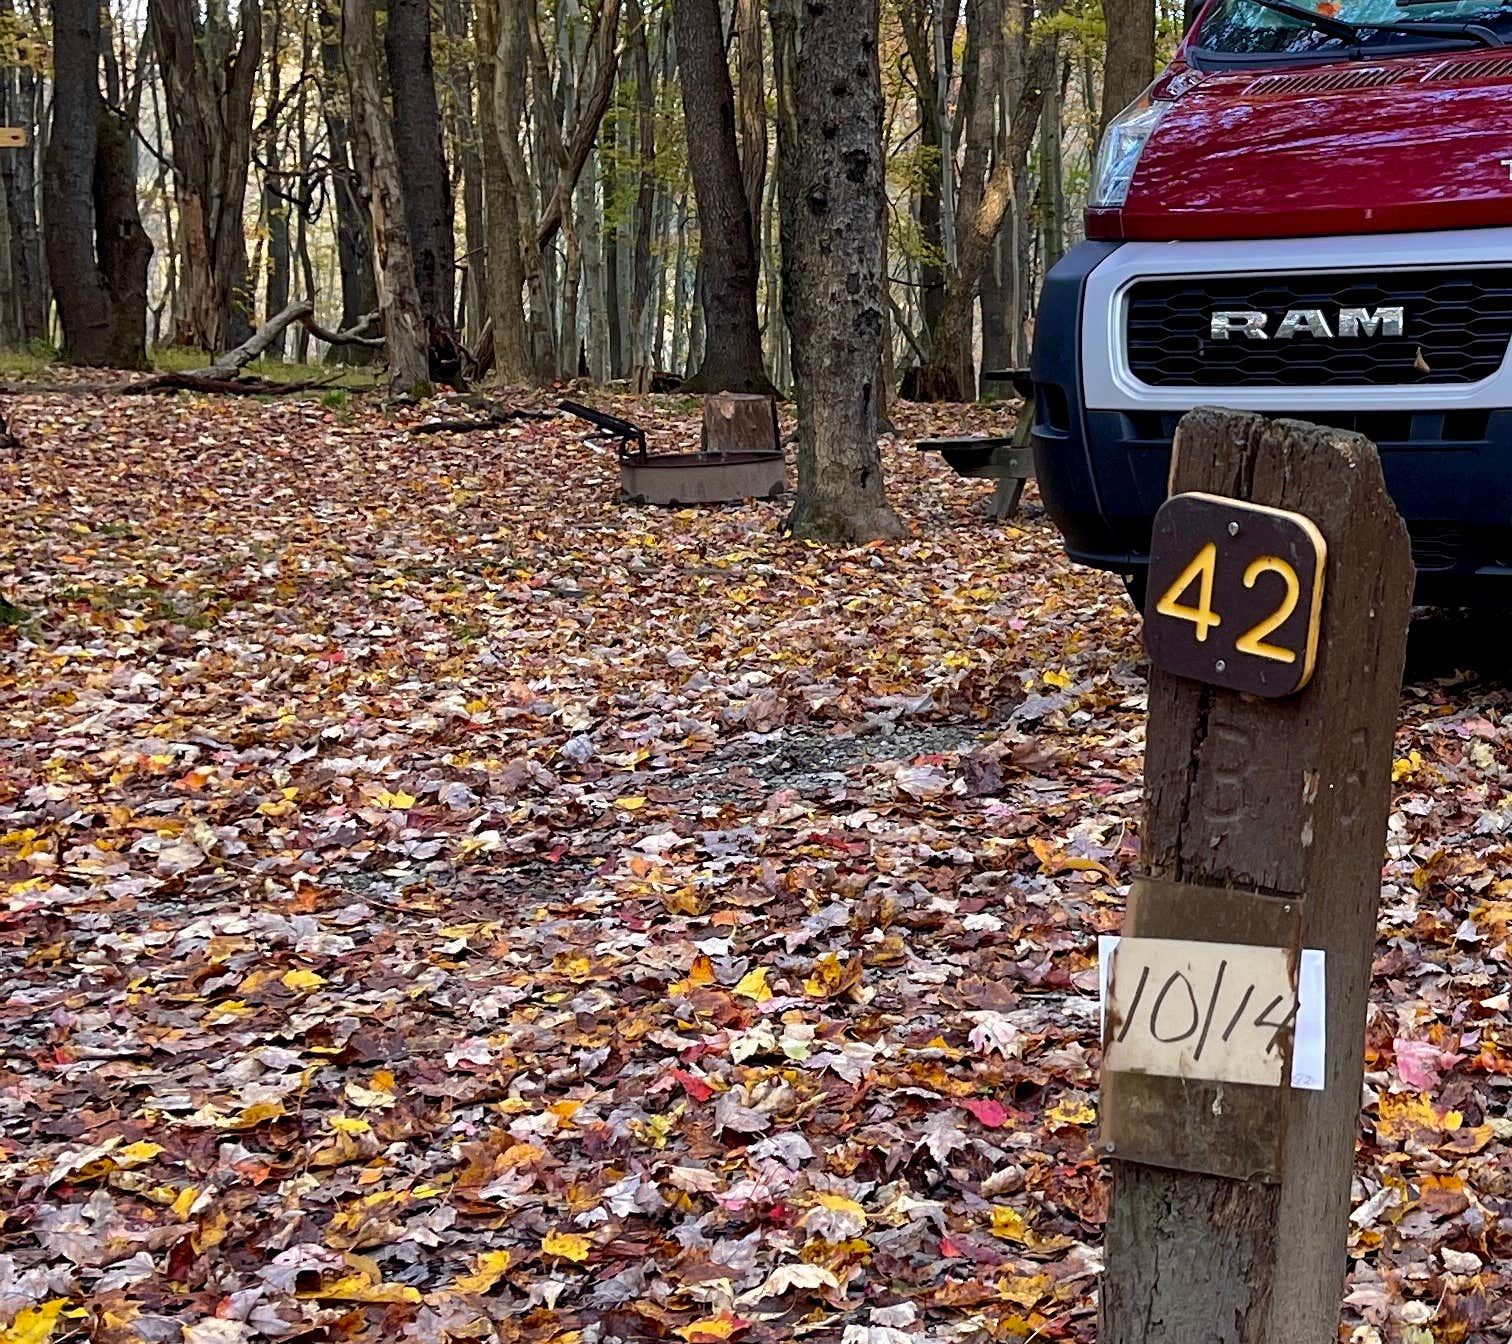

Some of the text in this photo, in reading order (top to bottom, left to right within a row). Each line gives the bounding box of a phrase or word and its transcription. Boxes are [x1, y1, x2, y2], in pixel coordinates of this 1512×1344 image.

[1210, 306, 1404, 340] RAM
[1155, 542, 1300, 664] 42
[1117, 959, 1300, 1061] 10/14
